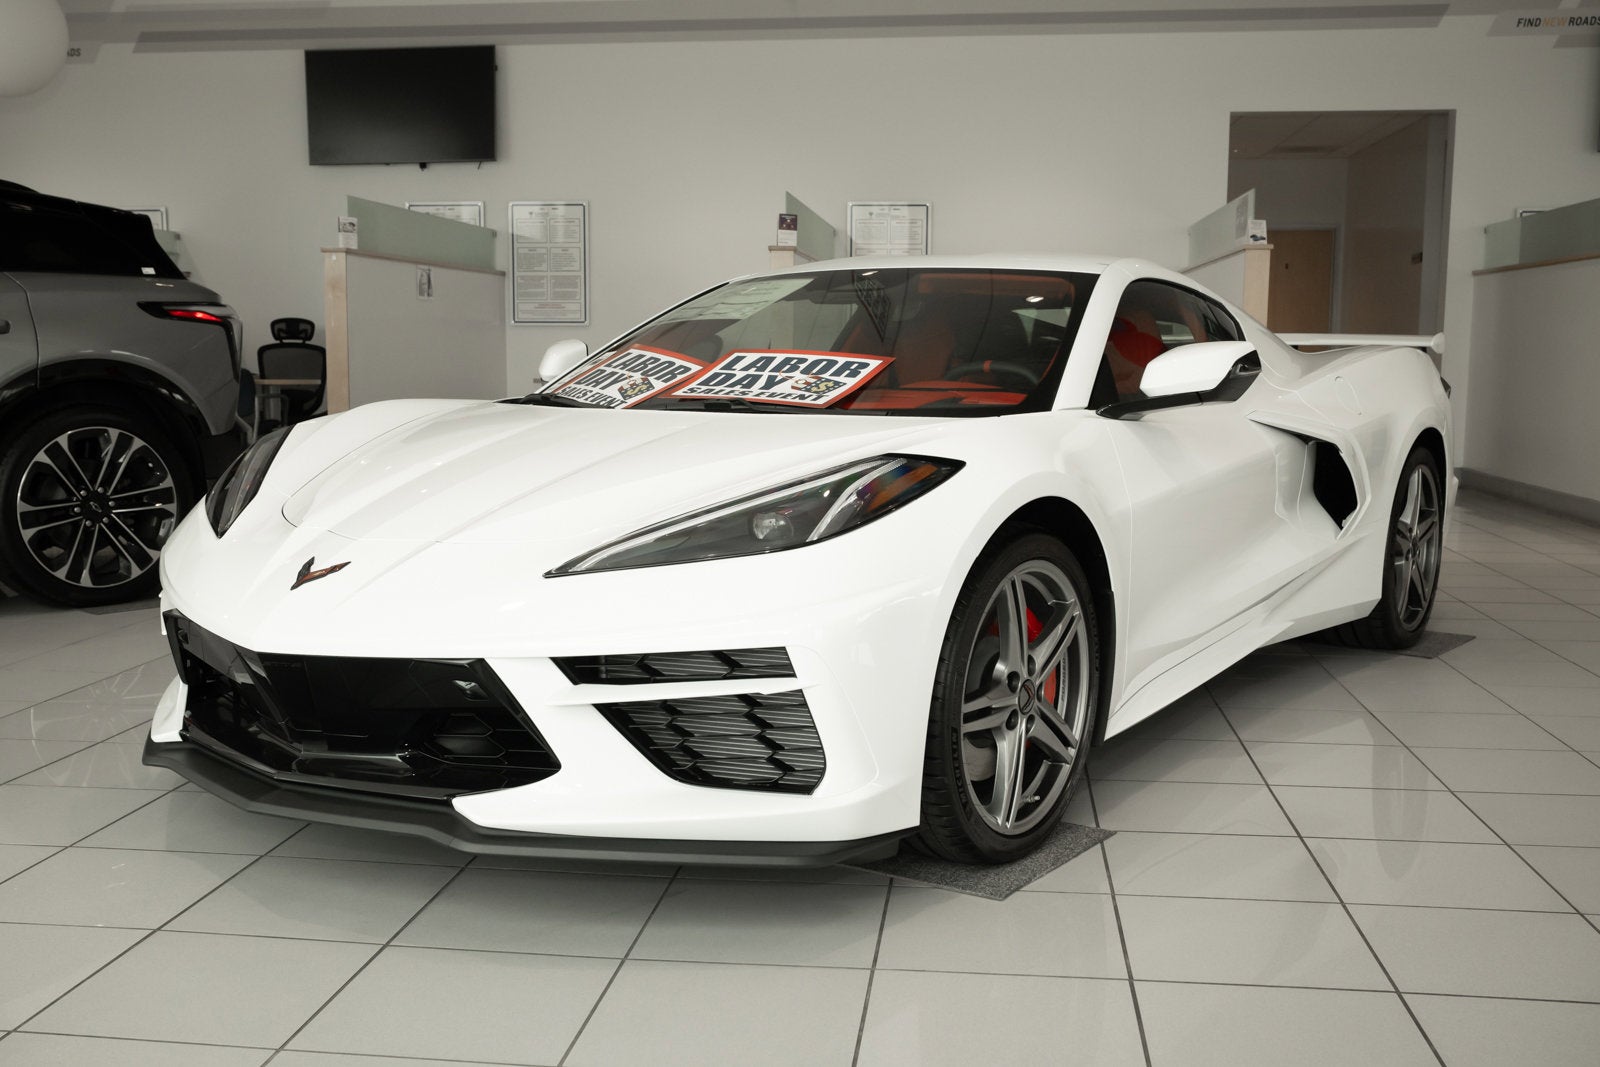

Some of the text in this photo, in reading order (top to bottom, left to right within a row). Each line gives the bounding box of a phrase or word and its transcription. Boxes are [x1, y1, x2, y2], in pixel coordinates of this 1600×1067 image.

[1516, 17, 1542, 28] FIND
[1542, 16, 1568, 28] NEW
[602, 352, 692, 384] LABOR
[718, 355, 871, 379] LABOR
[573, 368, 633, 391] DAY
[696, 371, 792, 391] DAY
[558, 385, 628, 408] SALES EVENT
[682, 386, 829, 402] SALES EVENT
[951, 731, 968, 804] MICHELIN
